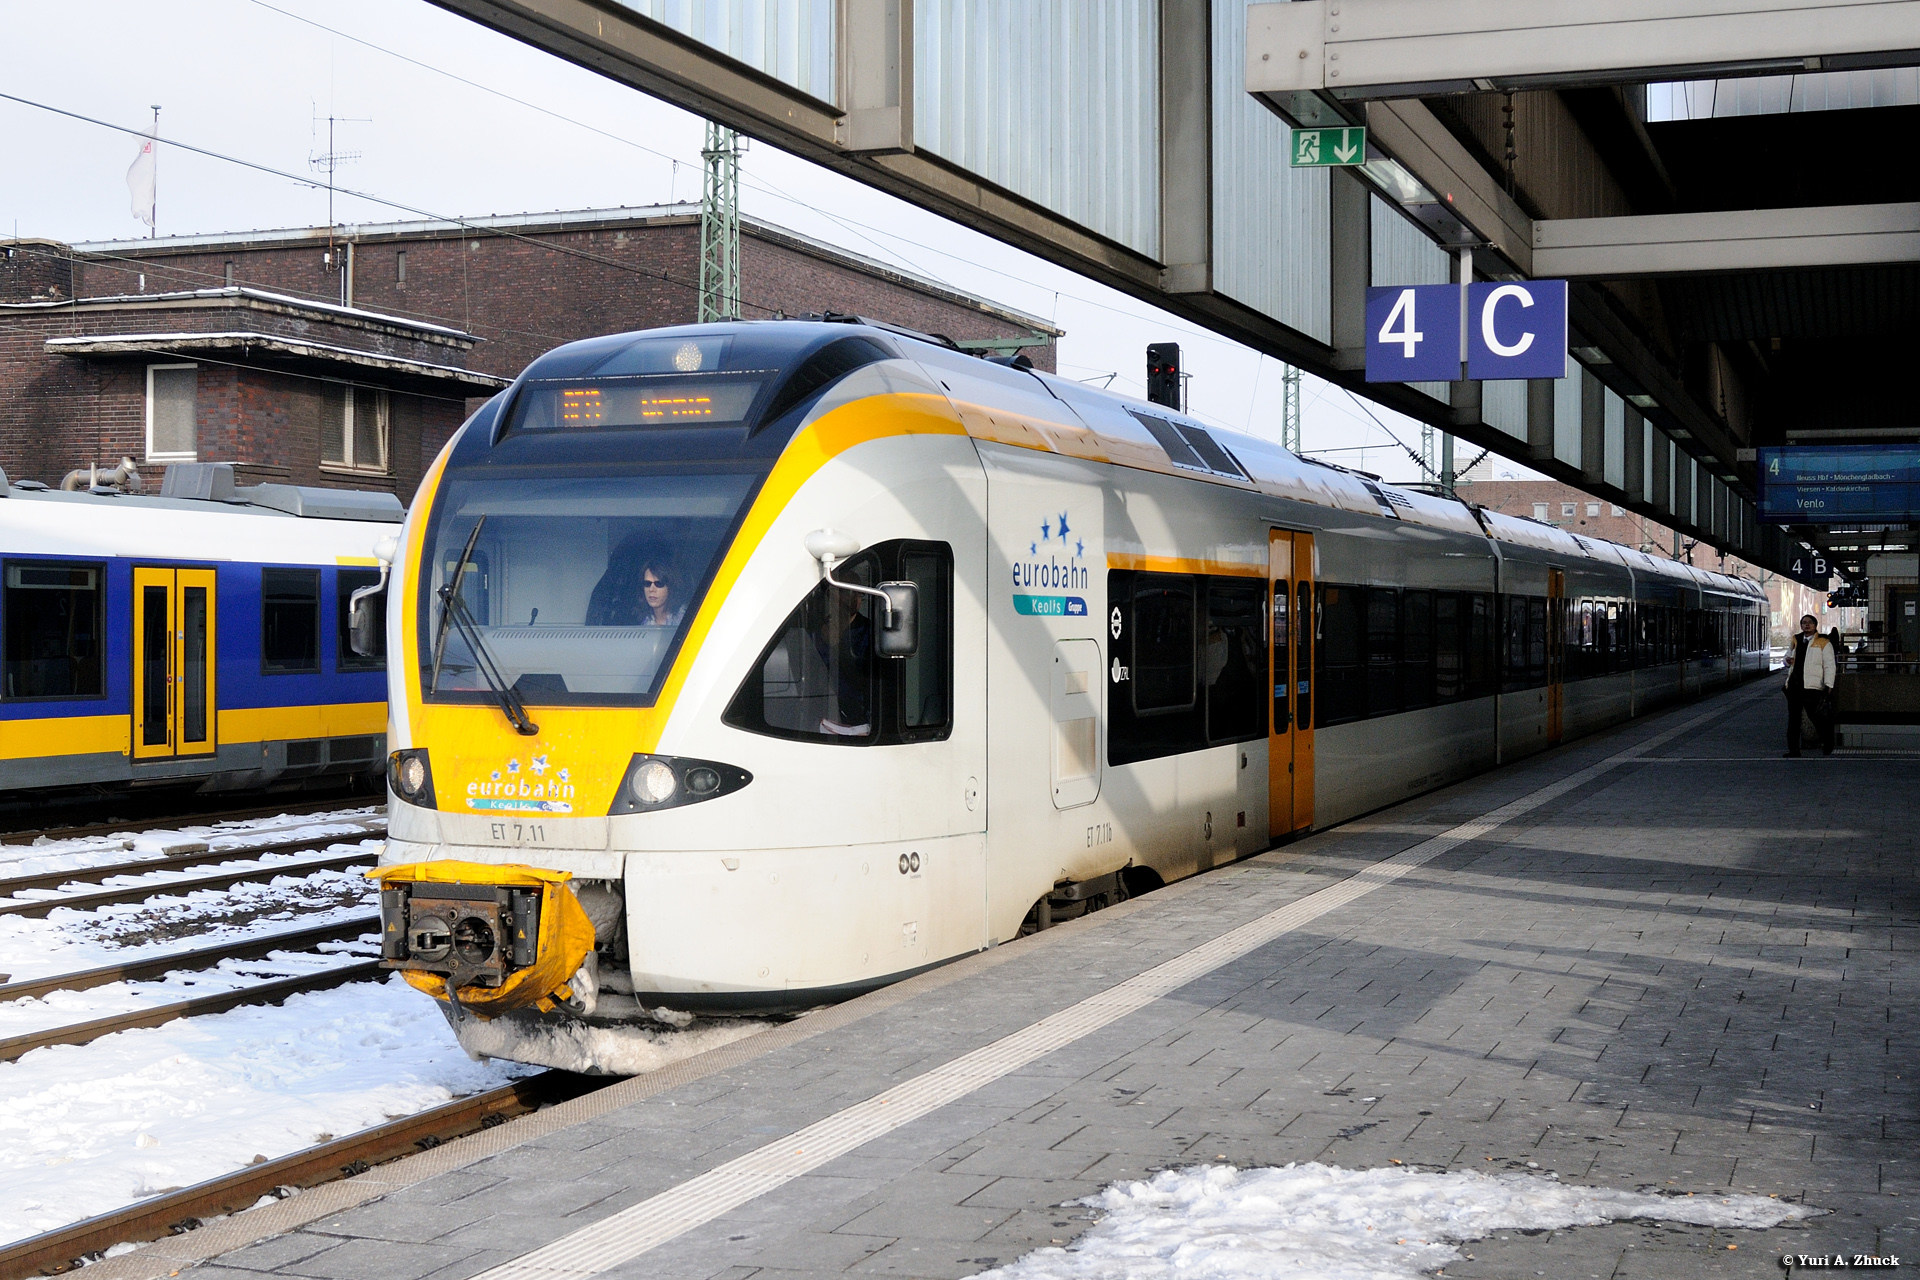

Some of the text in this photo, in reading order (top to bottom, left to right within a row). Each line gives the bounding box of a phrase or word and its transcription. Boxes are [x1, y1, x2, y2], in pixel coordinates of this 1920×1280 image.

[1378, 284, 1536, 359] 4 C
[1769, 458, 1780, 476] 4
[1825, 485, 1870, 493] Kaldenkirchen
[1796, 499, 1825, 509] Venlo
[1012, 555, 1088, 590] eurobahn
[1791, 558, 1827, 574] 4 B
[1852, 587, 1860, 597] A
[1031, 599, 1062, 614] Keolis
[1316, 602, 1323, 640] 2
[467, 778, 575, 798] eurobahn
[491, 823, 545, 842] ET 7.11
[1087, 826, 1094, 848] ET
